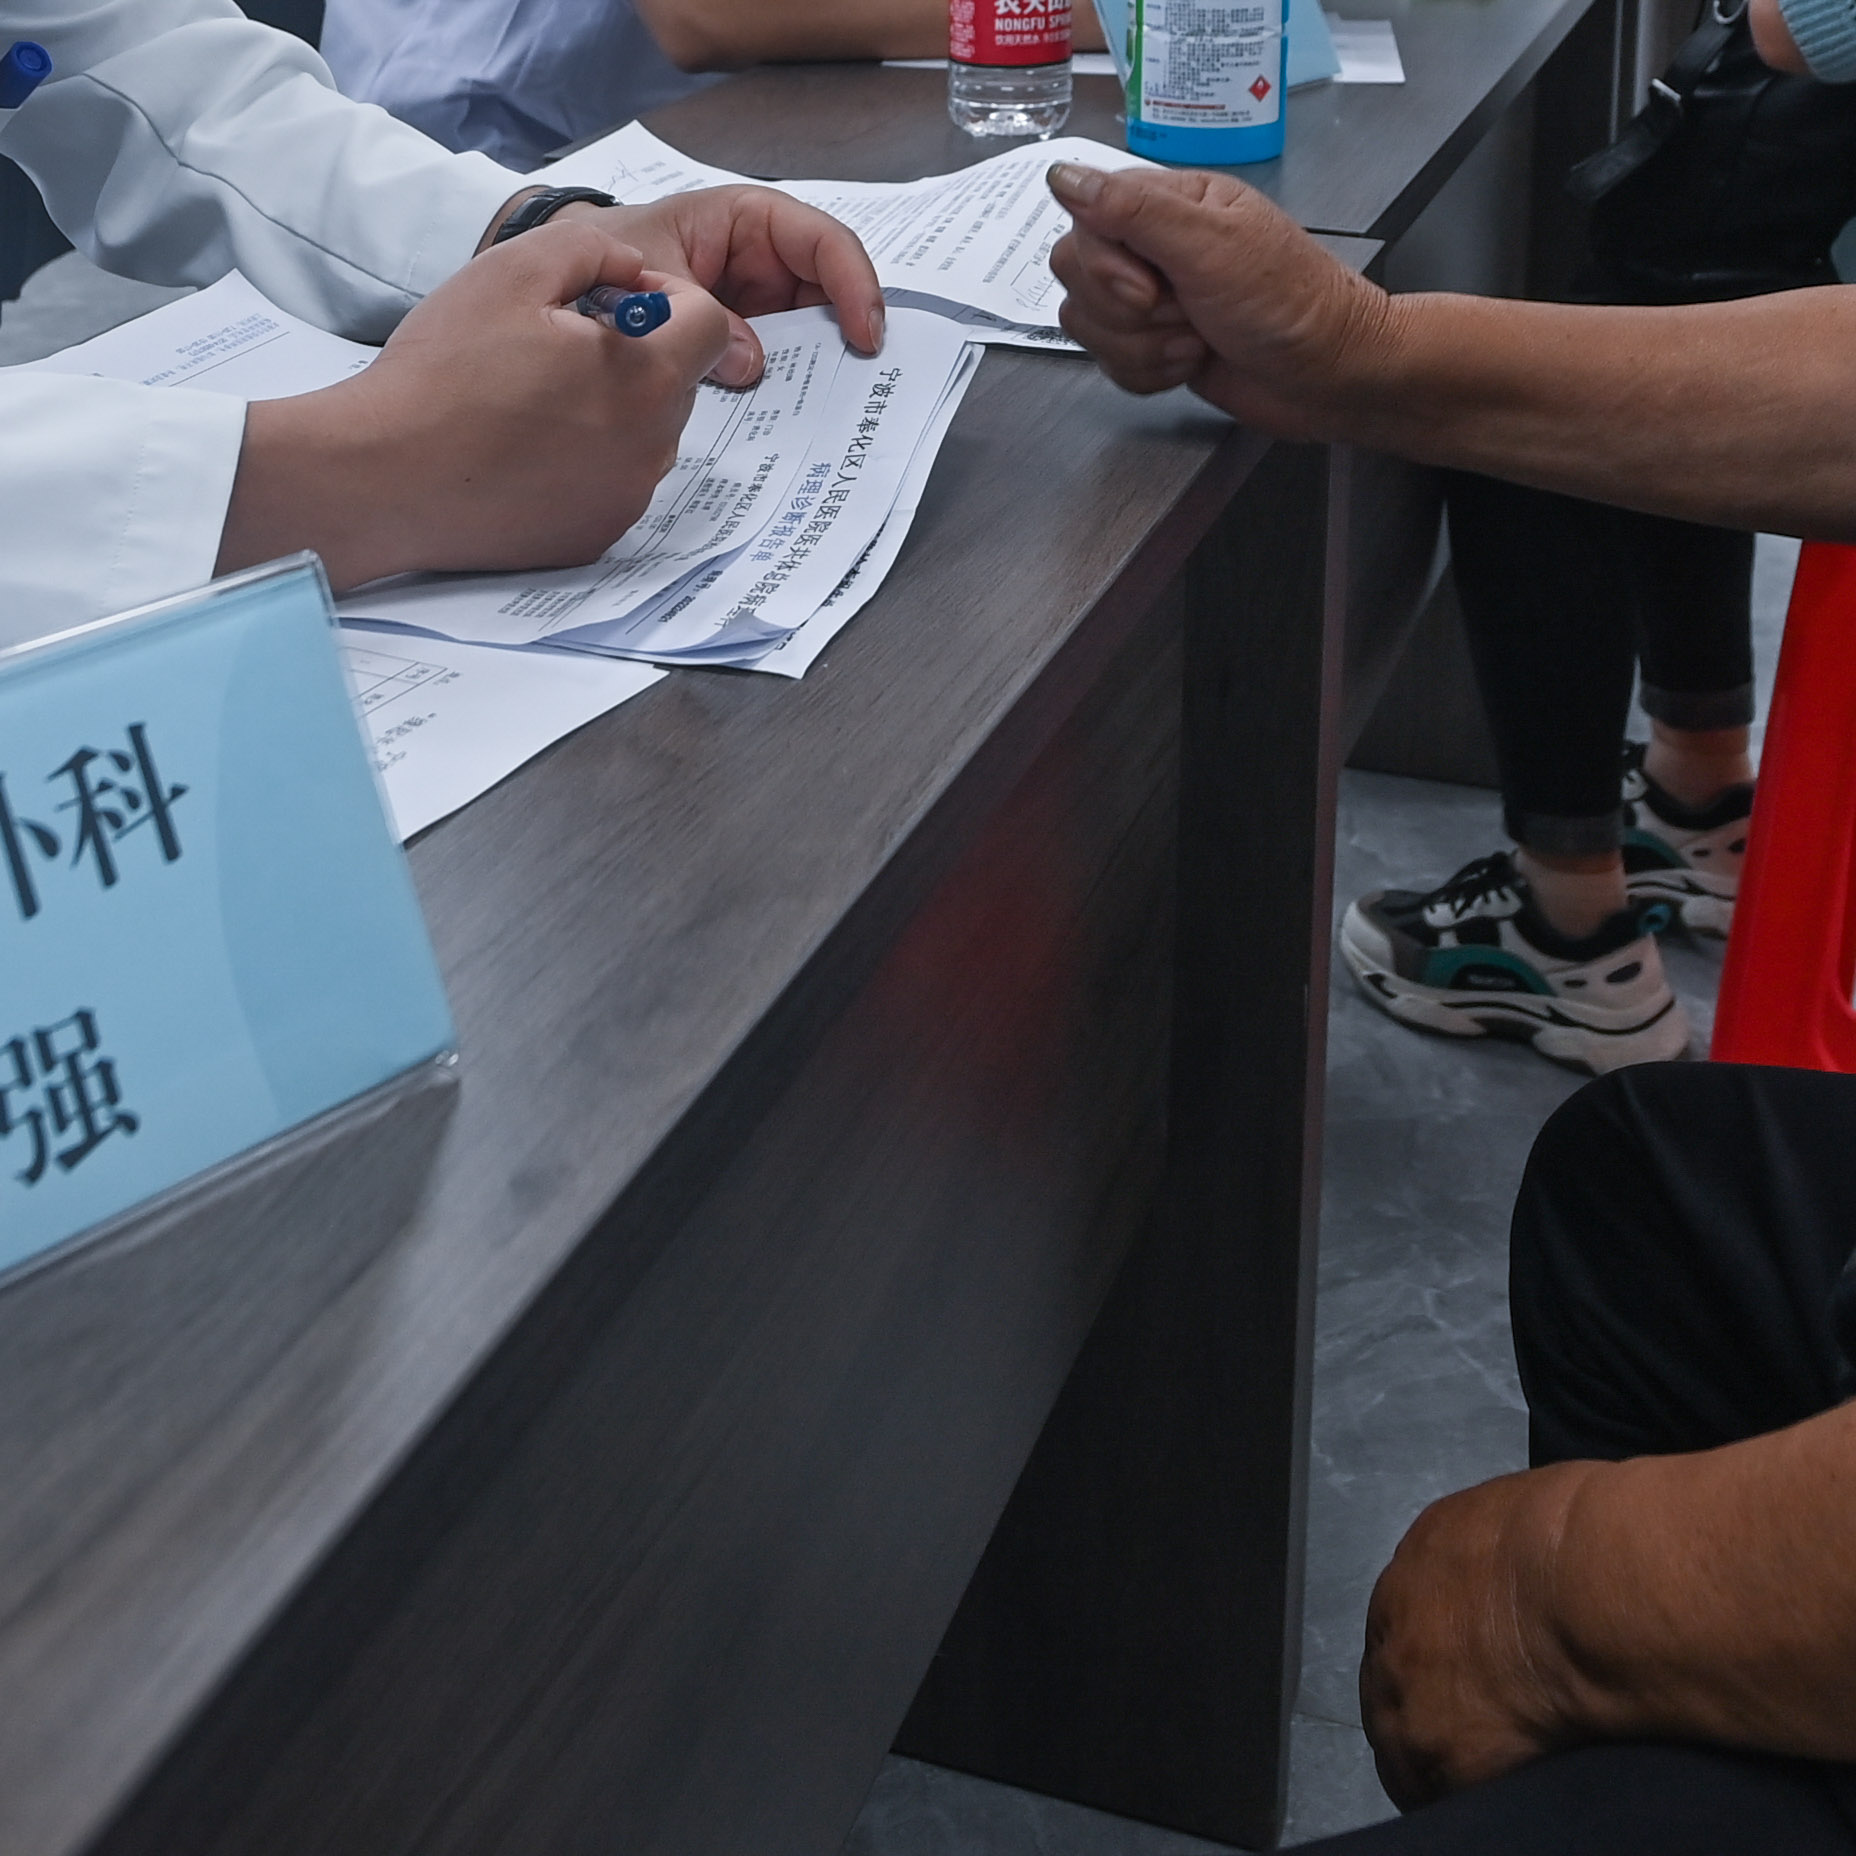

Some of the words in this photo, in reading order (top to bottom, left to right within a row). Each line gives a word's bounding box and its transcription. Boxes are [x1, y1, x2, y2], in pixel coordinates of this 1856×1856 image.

[994, 16, 1046, 32] NONGFU
[749, 462, 832, 563] 病理诊断报告单
